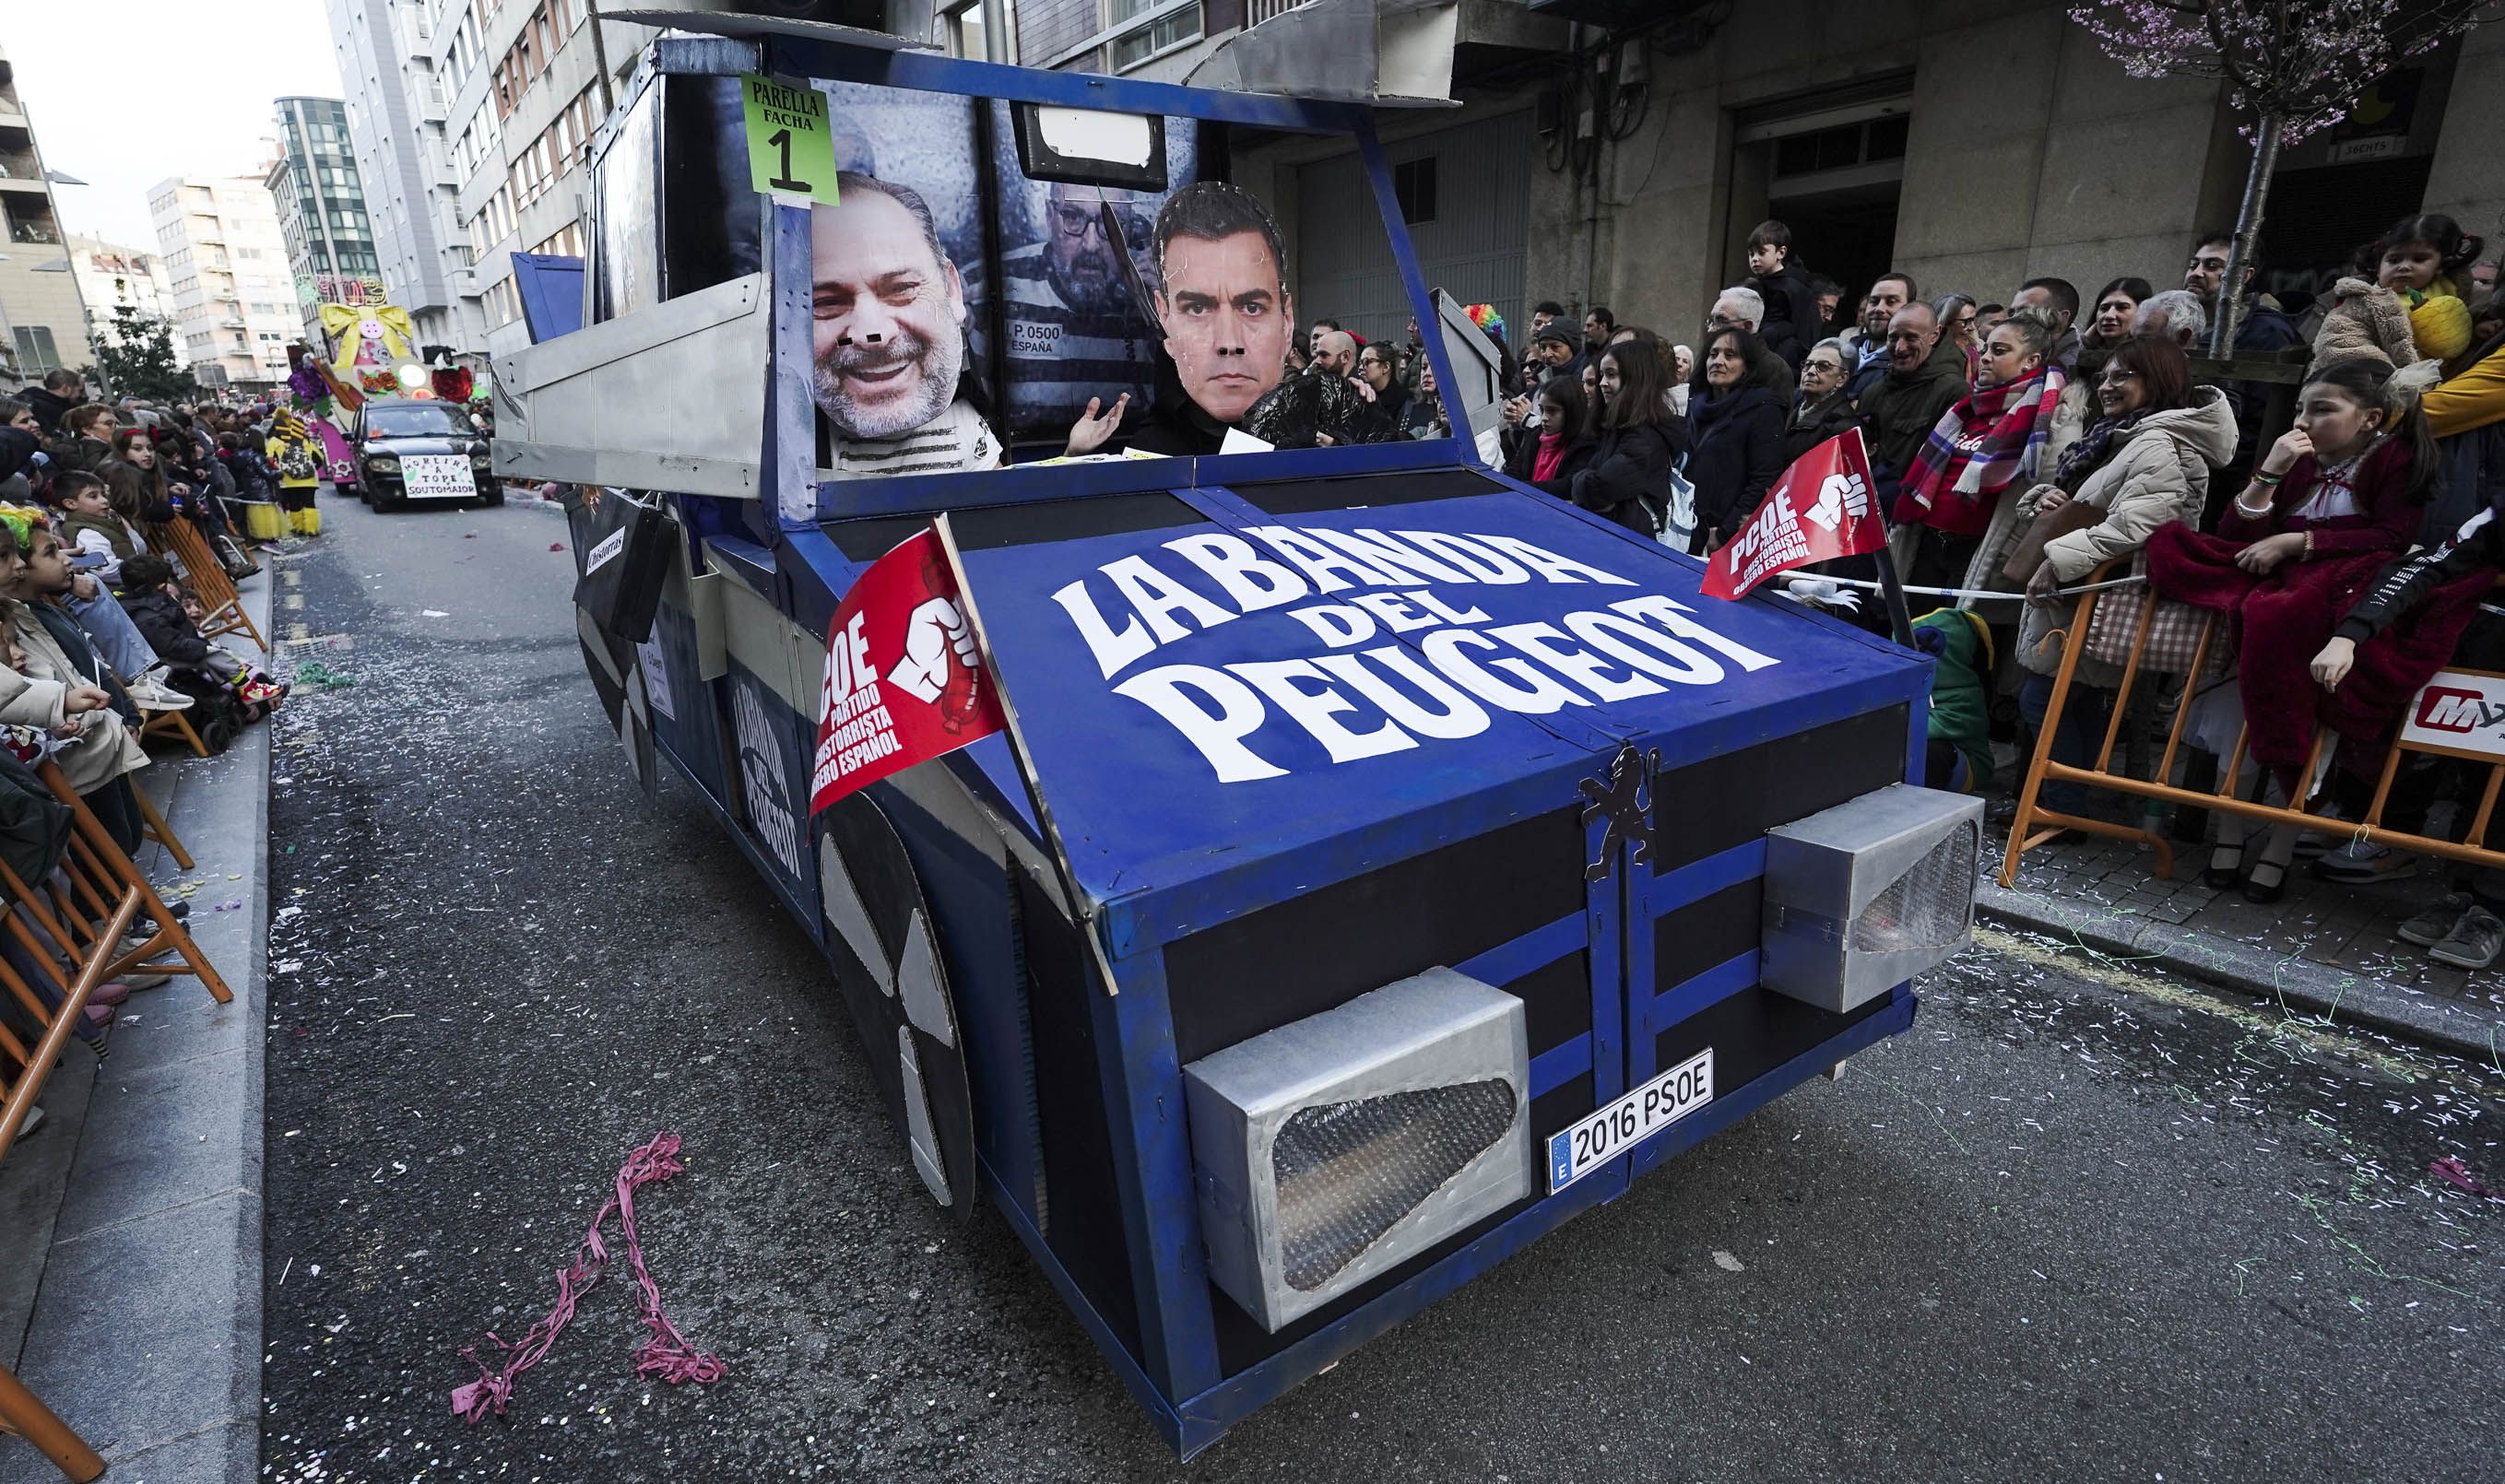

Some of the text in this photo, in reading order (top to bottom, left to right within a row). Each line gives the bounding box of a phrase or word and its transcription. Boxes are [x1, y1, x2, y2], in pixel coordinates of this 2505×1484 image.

[752, 81, 820, 117] PARELLA
[763, 109, 814, 131] FACHA
[768, 128, 812, 193] 1
[1011, 340, 1052, 352] ESPAÑA
[1027, 326, 1059, 339] 0500
[408, 486, 474, 495] SOUTOMAIOR
[589, 536, 622, 569] Chistorras
[1731, 485, 1797, 575] PCOE
[1759, 518, 1799, 551] PARTIDO
[1733, 543, 1811, 595] OBRERO ESPAÑOL
[1743, 529, 1807, 580] CHISTORRISTA
[1050, 525, 1640, 682] LA BANDA
[1286, 590, 1493, 648] DEL
[831, 683, 880, 730] PARTIDO
[1110, 595, 1782, 783] PEUGEOT
[838, 728, 903, 776] ESPAÑOL
[753, 753, 773, 799] DEL
[741, 758, 802, 882] PEUGEOT
[1576, 1061, 1706, 1167] 2016 PSOE
[1558, 1162, 1567, 1180] E
